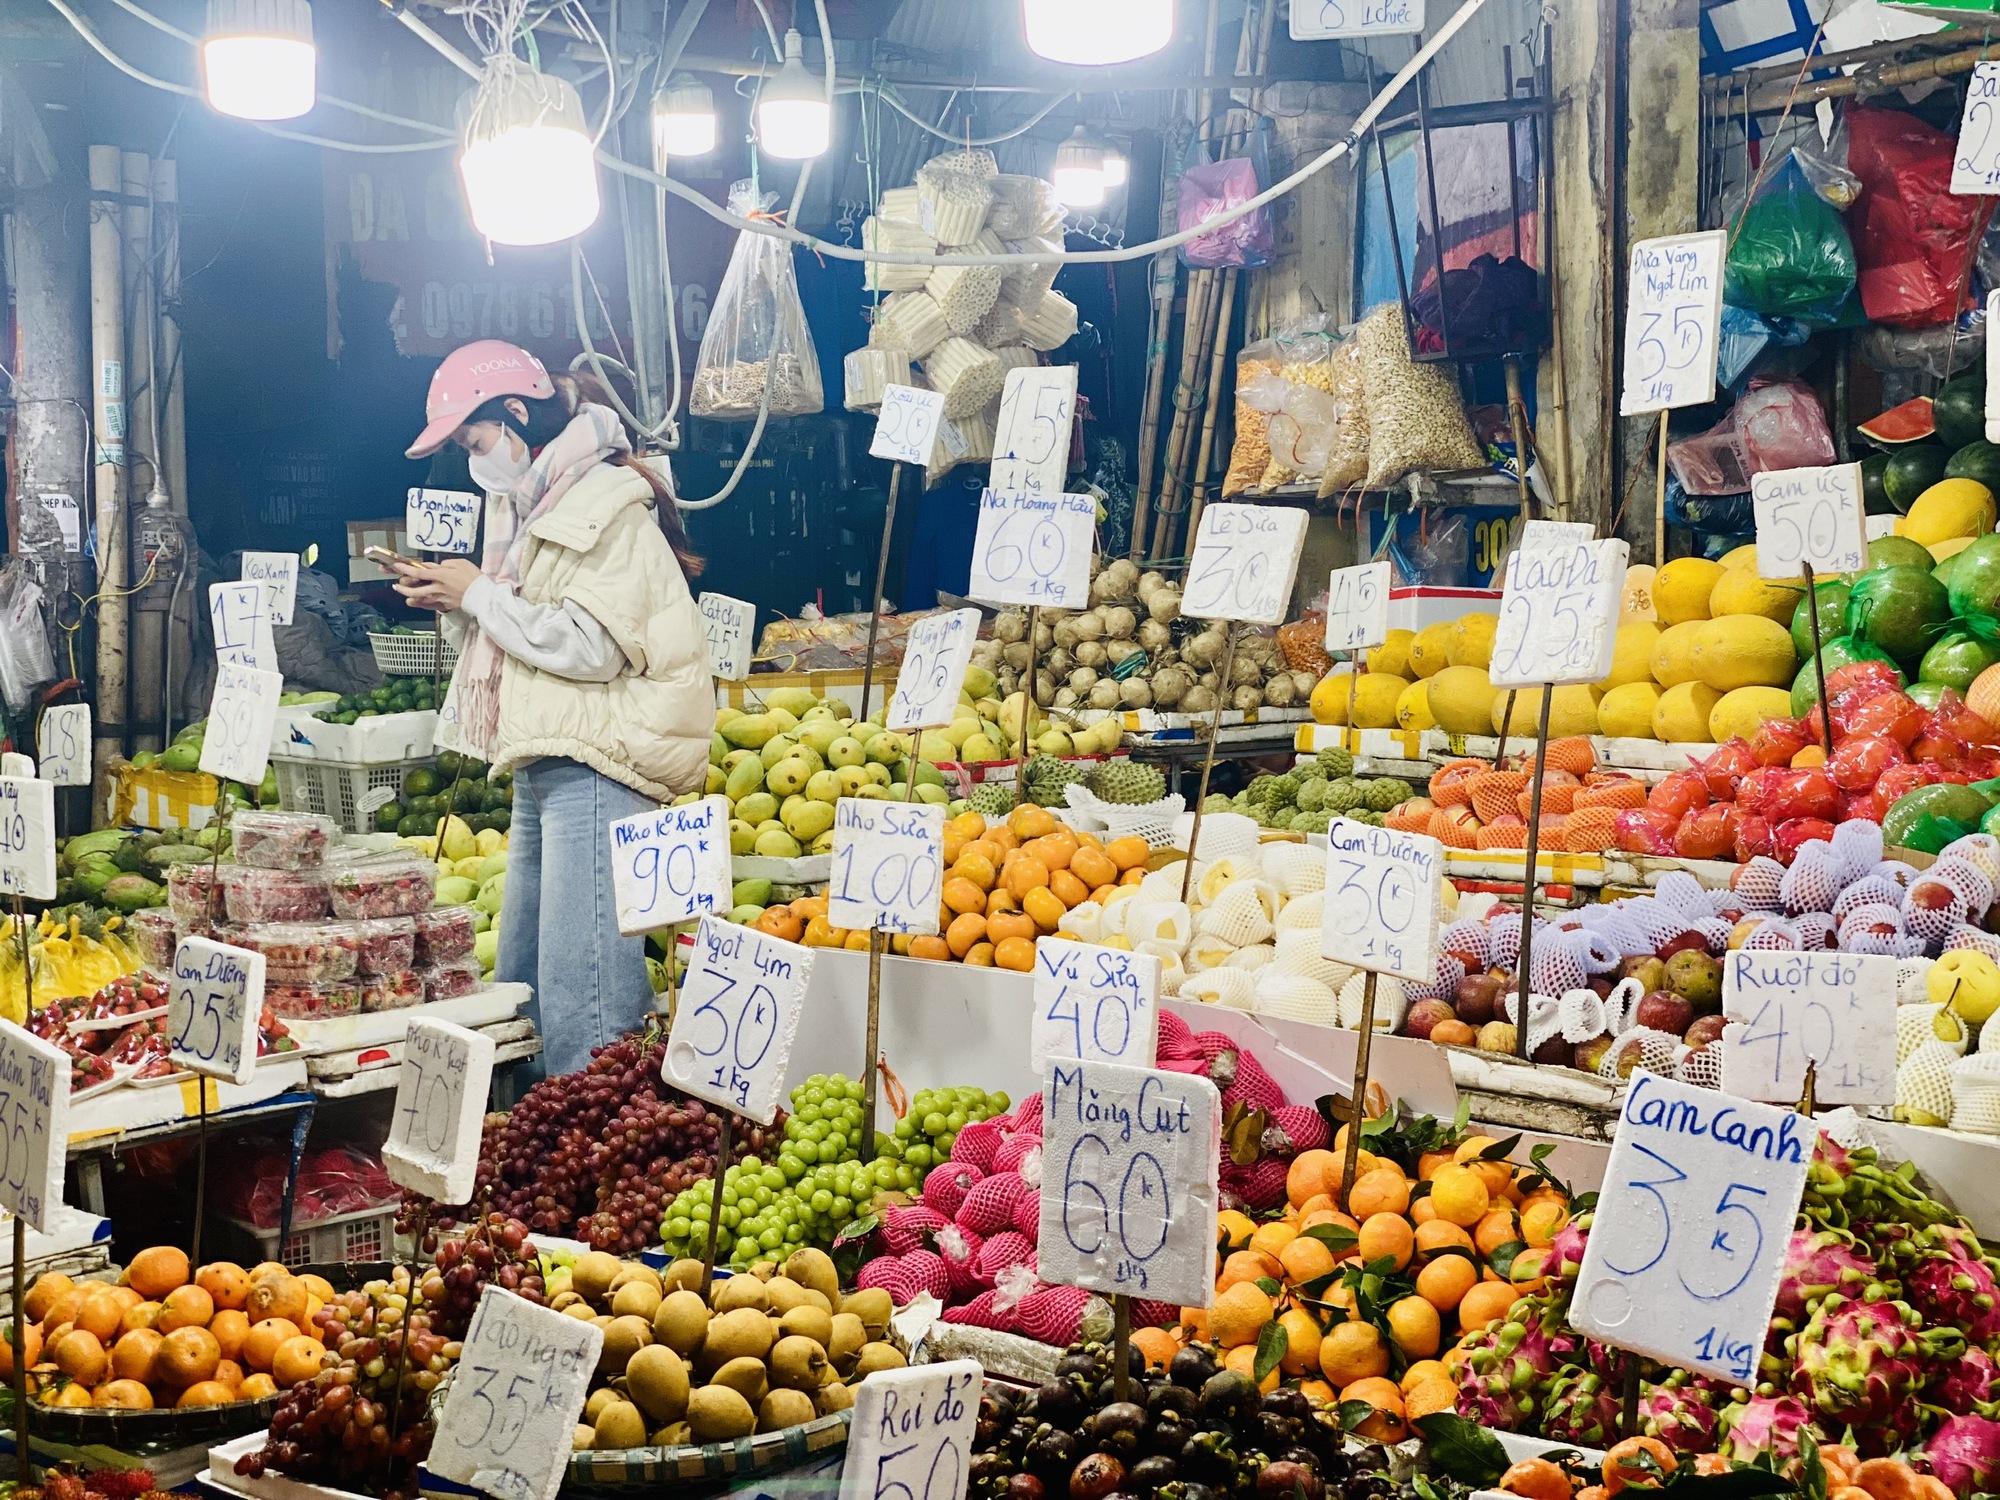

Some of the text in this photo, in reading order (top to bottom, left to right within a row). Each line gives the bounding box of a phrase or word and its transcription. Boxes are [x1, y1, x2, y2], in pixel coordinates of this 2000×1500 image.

[469, 358, 521, 376] YOONA
[983, 491, 1006, 509] Na
[1754, 478, 1809, 501] Cam
[1330, 822, 1366, 853] Cam
[1052, 1066, 1131, 1142] Măng
[1626, 1078, 1707, 1135] Cam
